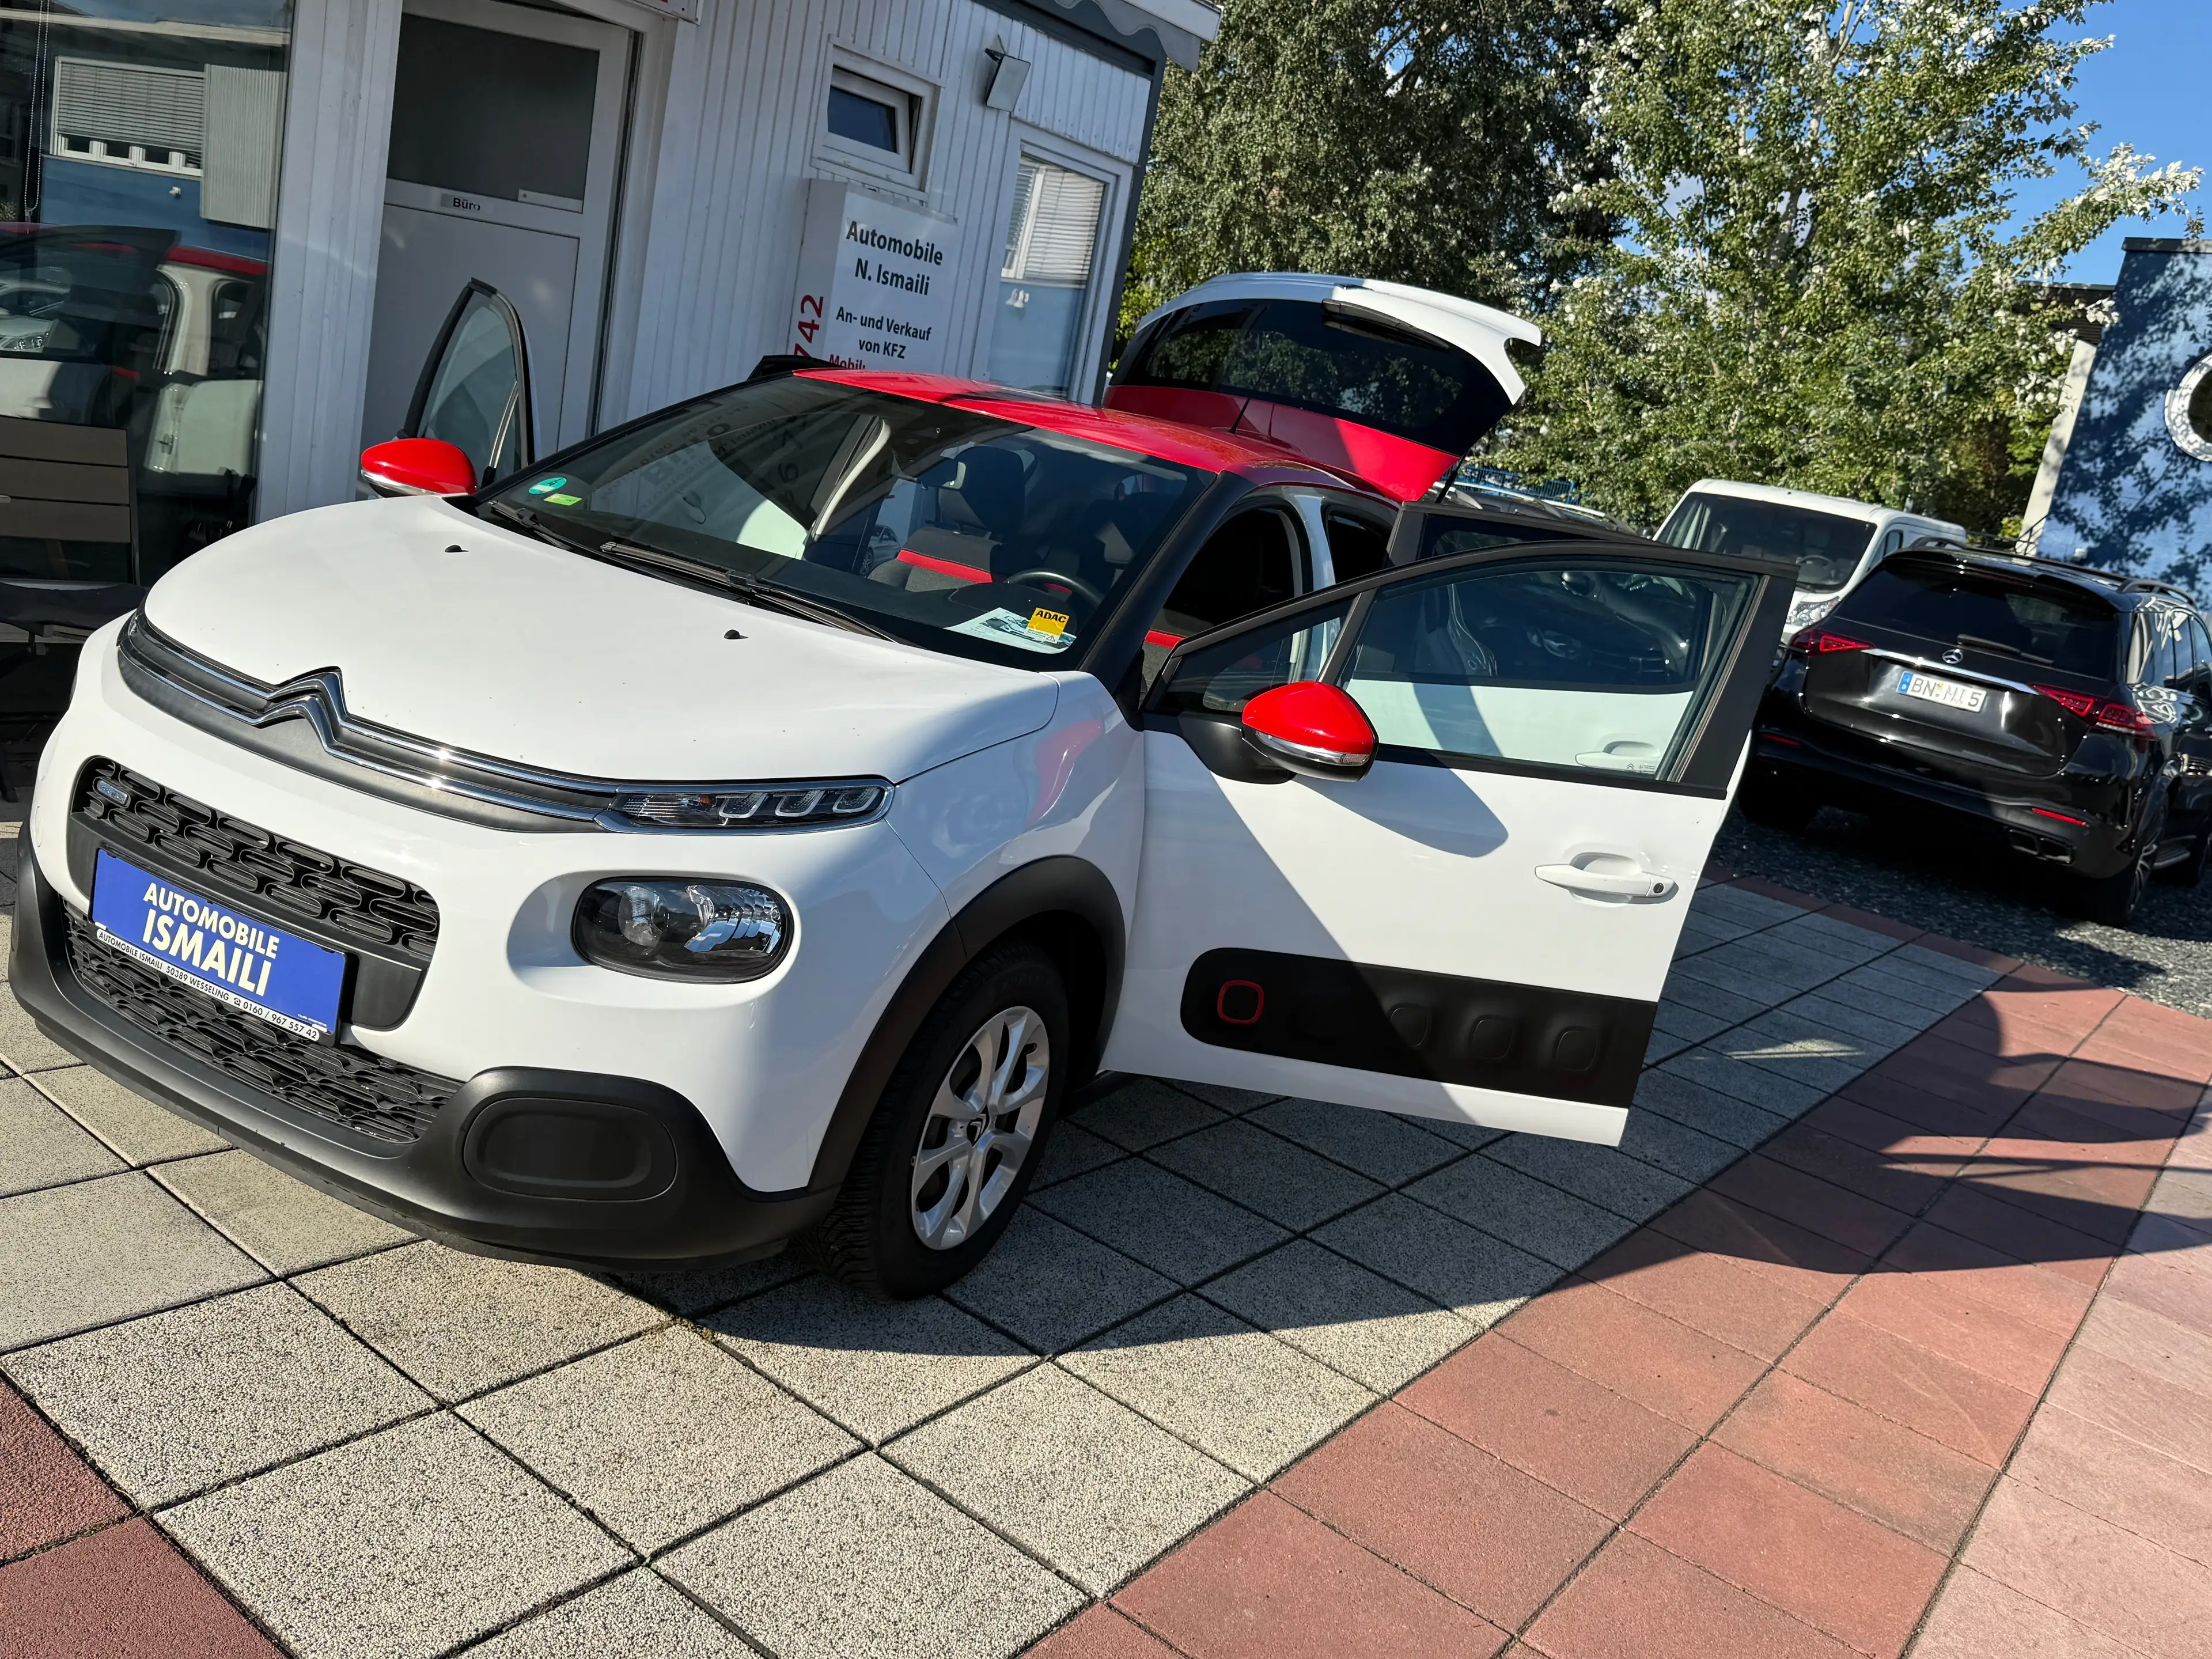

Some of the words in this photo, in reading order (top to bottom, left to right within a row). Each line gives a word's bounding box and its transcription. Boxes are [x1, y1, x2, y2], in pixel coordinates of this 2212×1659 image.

[453, 197, 480, 211] Büro
[846, 220, 944, 266] Automobile
[855, 257, 872, 282] N.
[876, 263, 930, 296] Ismaili
[836, 306, 858, 324] An-
[860, 313, 882, 331] und
[886, 317, 932, 342] Verkauf
[859, 338, 880, 354] von
[882, 342, 907, 359] KFZ
[1035, 609, 1067, 623] ADAC
[1968, 691, 1982, 707] 5
[142, 882, 280, 959] AUTOMOBILE
[142, 909, 273, 997] ISMAILI
[98, 931, 139, 959] AUTOMOBILE
[138, 950, 163, 970] ISMAILI
[165, 965, 189, 983] 50389
[188, 976, 230, 1001] WESSELING
[243, 1000, 264, 1017] 0160
[271, 1013, 287, 1028] 967
[289, 1021, 305, 1033] 557
[306, 1029, 317, 1039] 42
